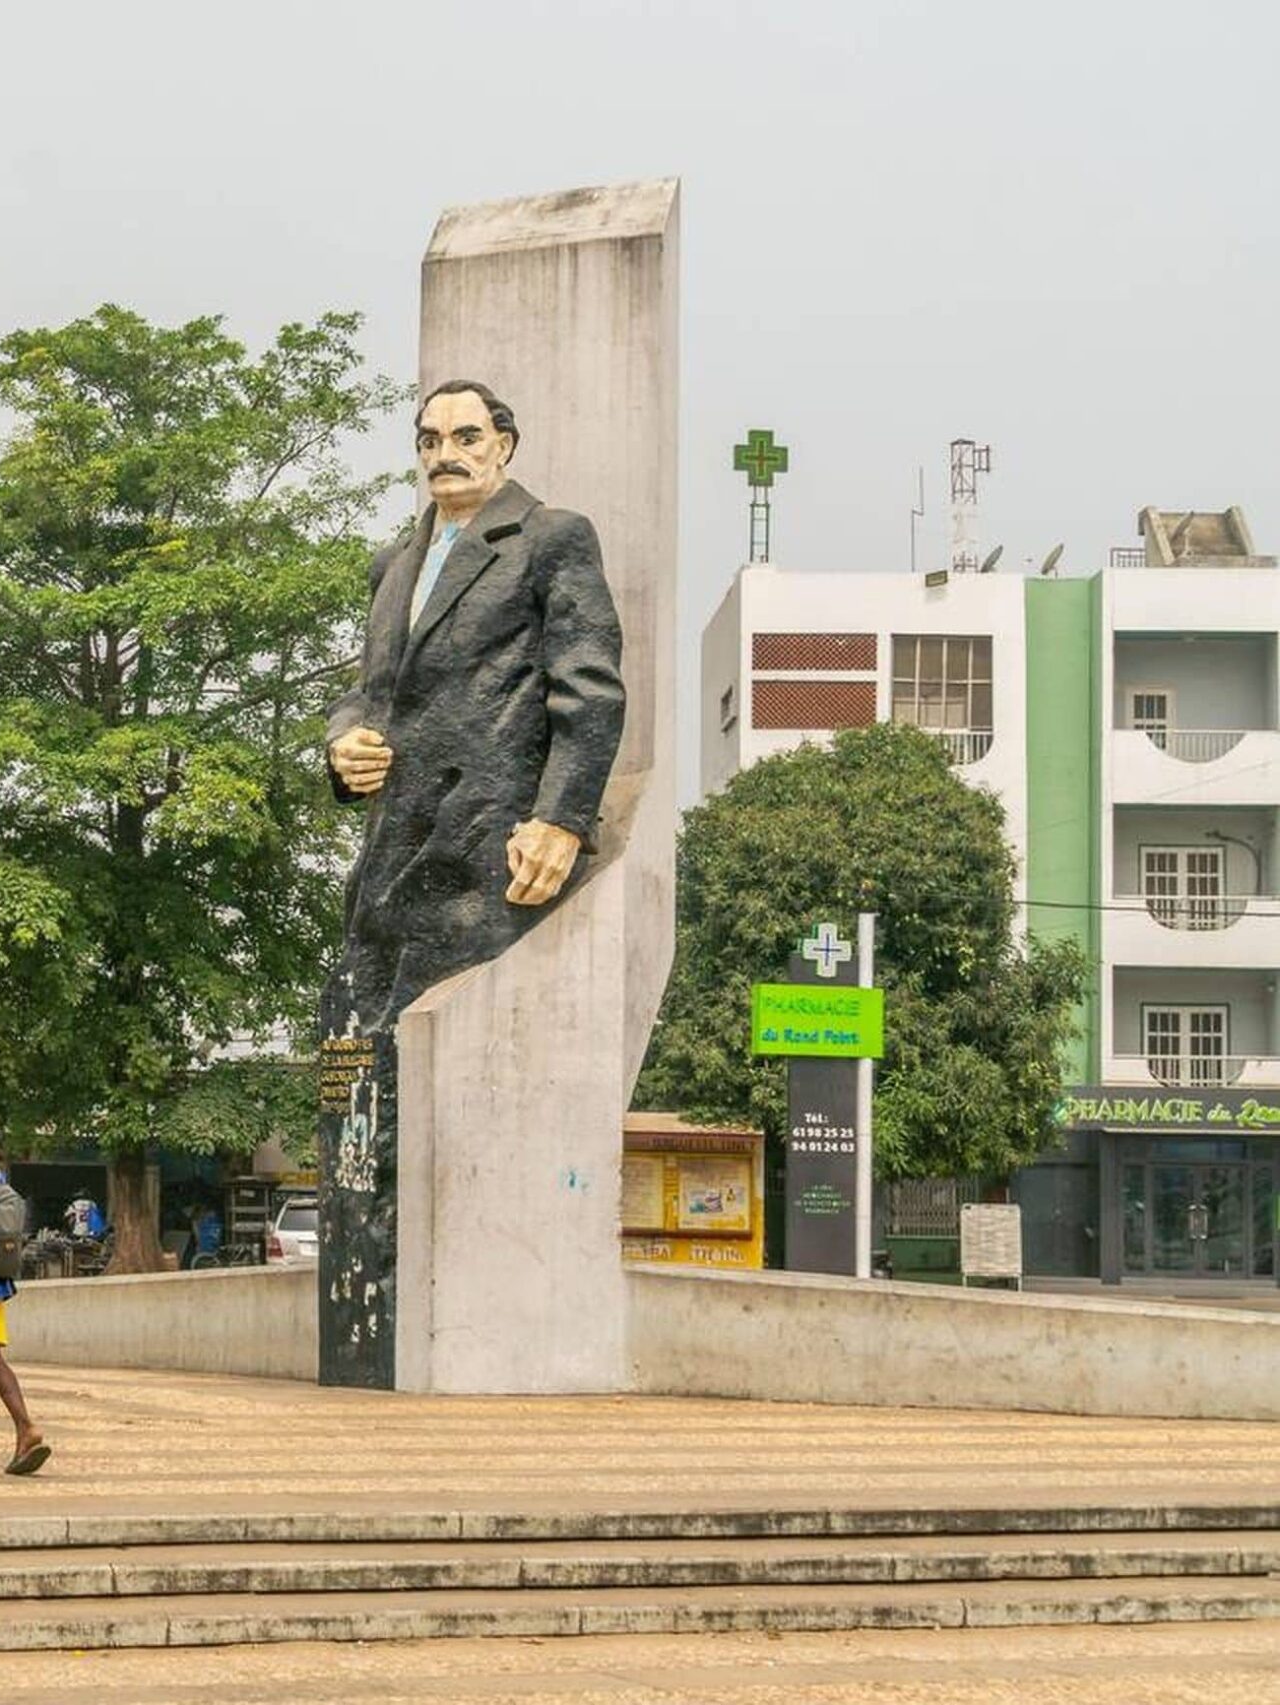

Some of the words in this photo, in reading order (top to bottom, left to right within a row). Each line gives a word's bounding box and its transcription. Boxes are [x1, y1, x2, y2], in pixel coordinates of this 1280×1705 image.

[762, 997, 860, 1017] PHARMACIE
[761, 1028, 778, 1042] du
[783, 1028, 819, 1043] Rond
[1067, 1096, 1204, 1123] PHARMACIE
[1207, 1103, 1232, 1121] du
